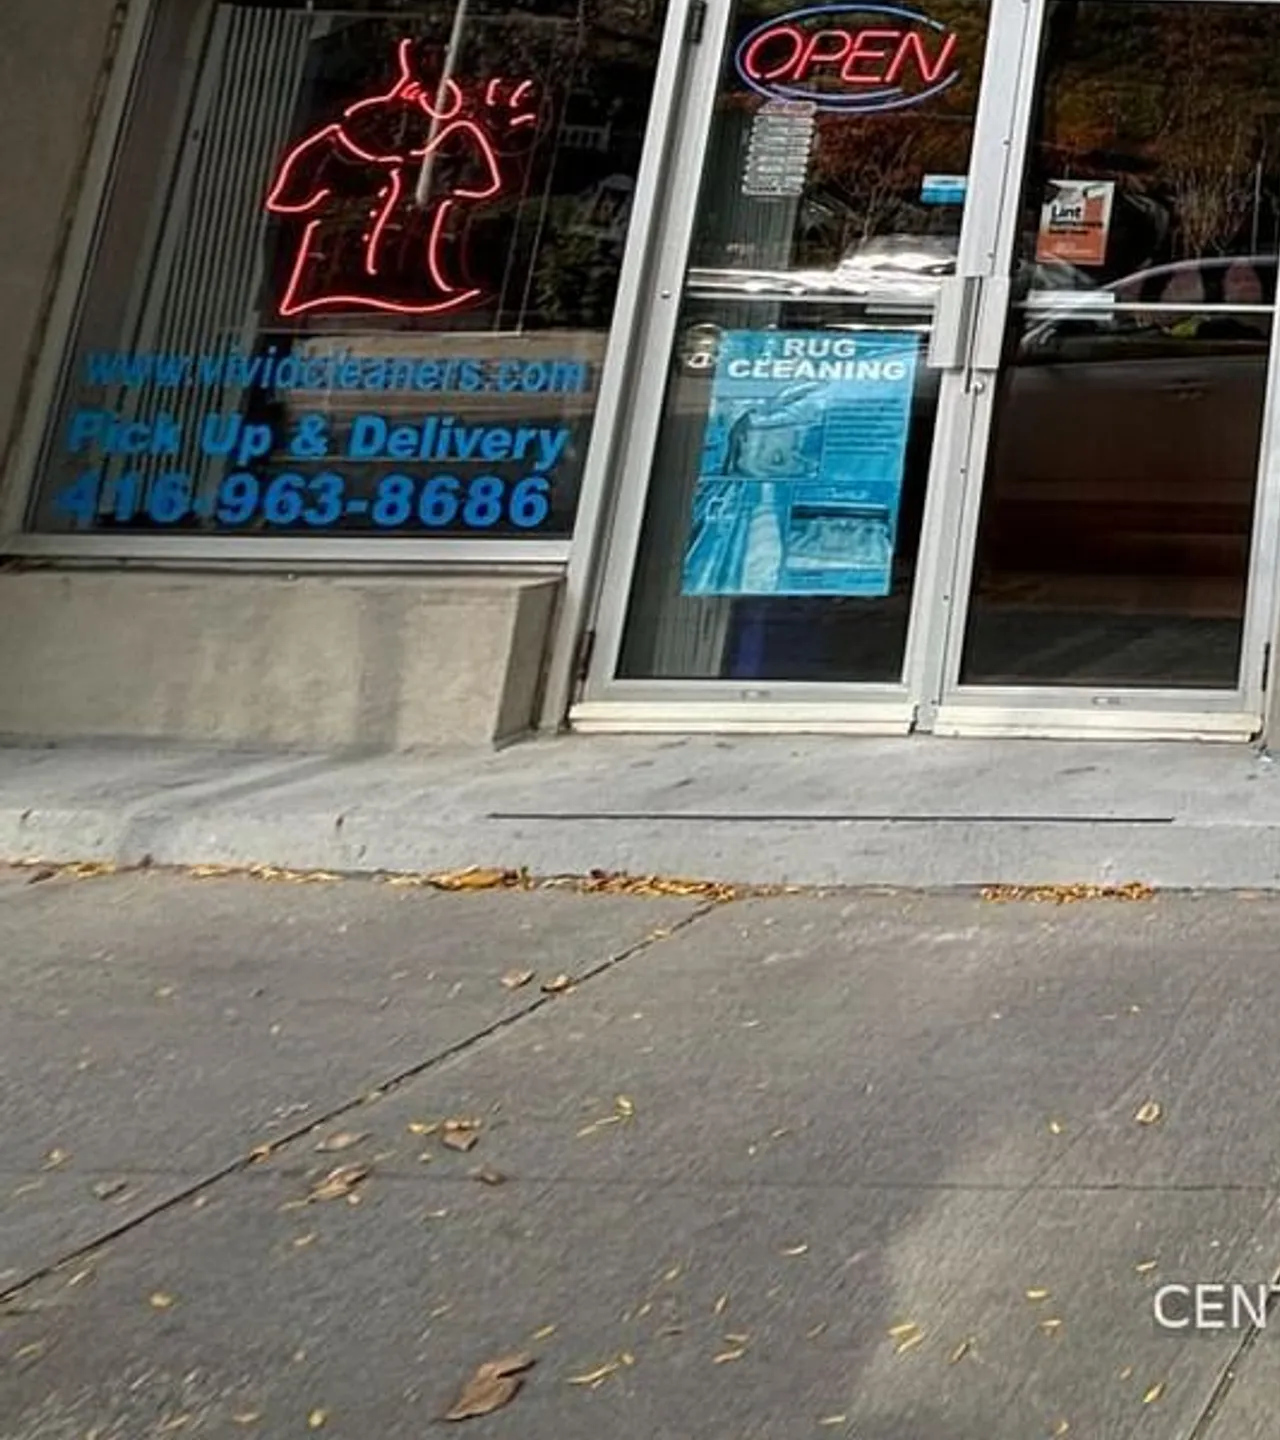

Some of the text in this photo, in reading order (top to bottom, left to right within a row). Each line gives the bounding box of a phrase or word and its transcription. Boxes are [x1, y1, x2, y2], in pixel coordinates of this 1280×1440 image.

[745, 27, 957, 82] OPEN
[86, 345, 588, 394] www.vividcleaners.com
[726, 359, 907, 381] CLEANING
[782, 337, 858, 358] RUG
[66, 411, 570, 469] Pick Up & Delivery
[55, 471, 550, 529] 416-963-8686
